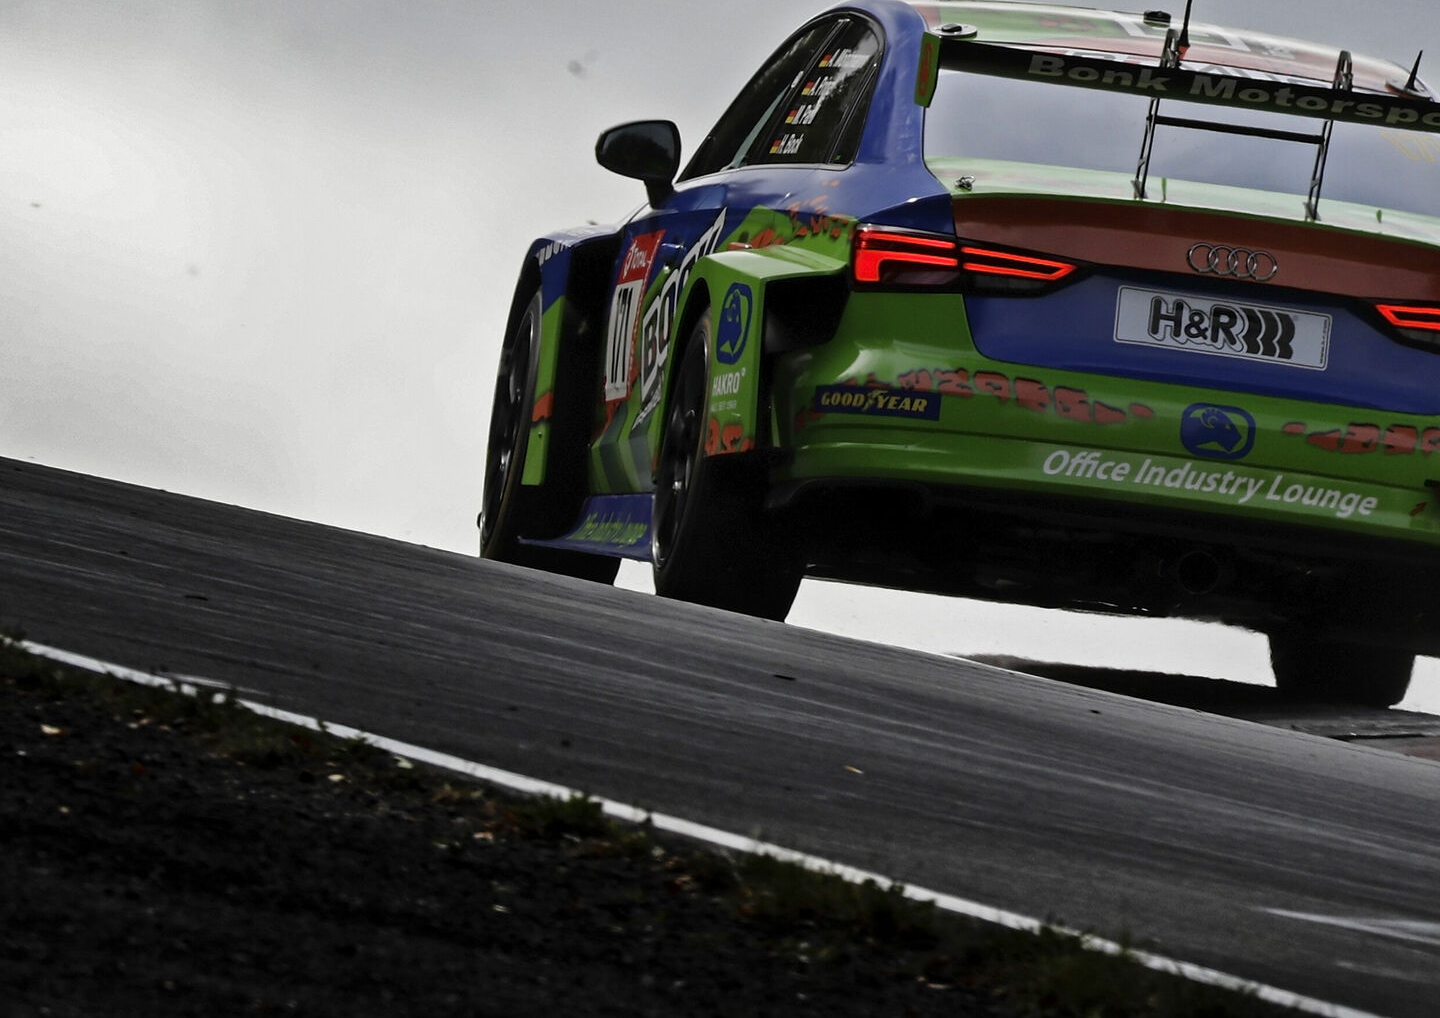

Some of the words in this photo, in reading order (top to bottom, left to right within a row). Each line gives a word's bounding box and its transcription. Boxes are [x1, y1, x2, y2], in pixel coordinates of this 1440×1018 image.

[1028, 54, 1172, 91] Bonk
[609, 286, 634, 384] 171
[1149, 296, 1244, 351] H&R
[712, 372, 740, 397] HAKRO
[1042, 449, 1131, 482] Office
[1135, 458, 1264, 504] Industry
[1266, 475, 1378, 518] Lounge
